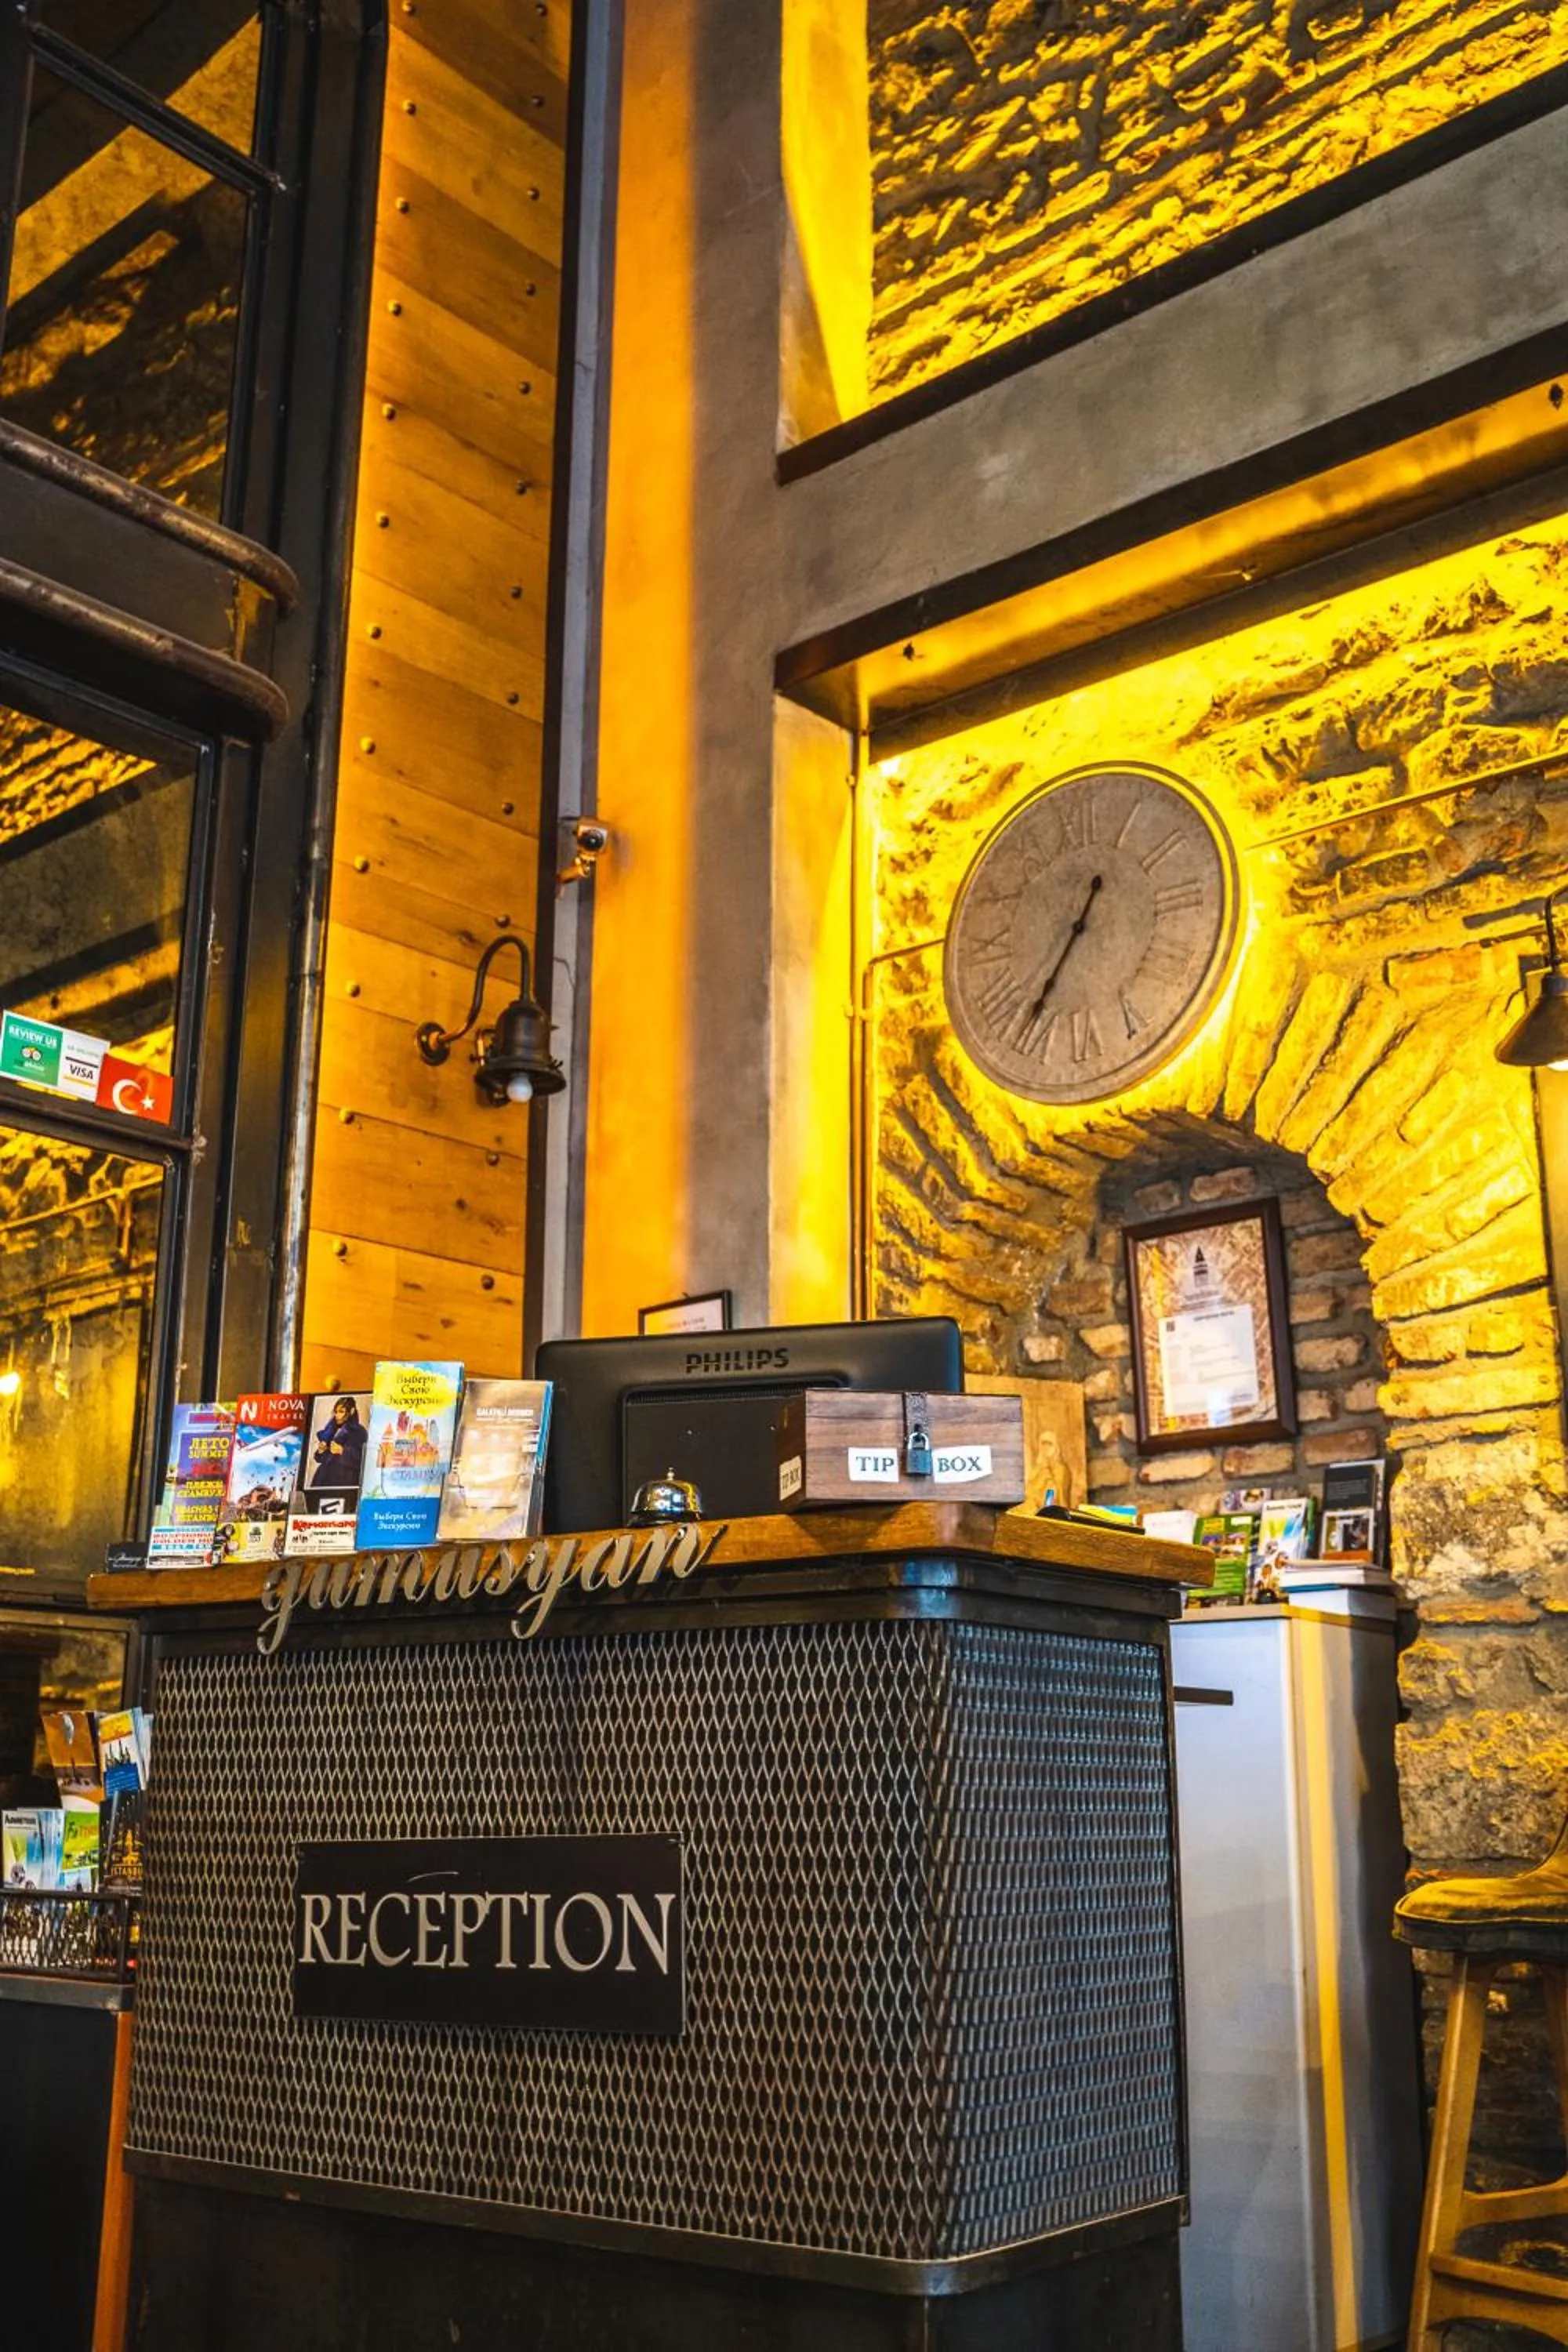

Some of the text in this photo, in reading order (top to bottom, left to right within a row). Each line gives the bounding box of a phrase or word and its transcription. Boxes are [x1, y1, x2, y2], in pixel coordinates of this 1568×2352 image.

[9, 1024, 57, 1048] REVIEW US
[70, 1063, 93, 1080] VISA
[686, 1348, 789, 1374] PHILIPS
[241, 1400, 258, 1422] N
[268, 1399, 305, 1411] NOVA
[267, 1413, 303, 1421] TRAVEL
[190, 1437, 230, 1450] ЛЕТО
[855, 1456, 982, 1472] TIP BOX
[373, 1512, 427, 1523] Выбери Свою
[378, 1521, 421, 1533] Экскурсию
[298, 1890, 676, 1975] RECEPTION
